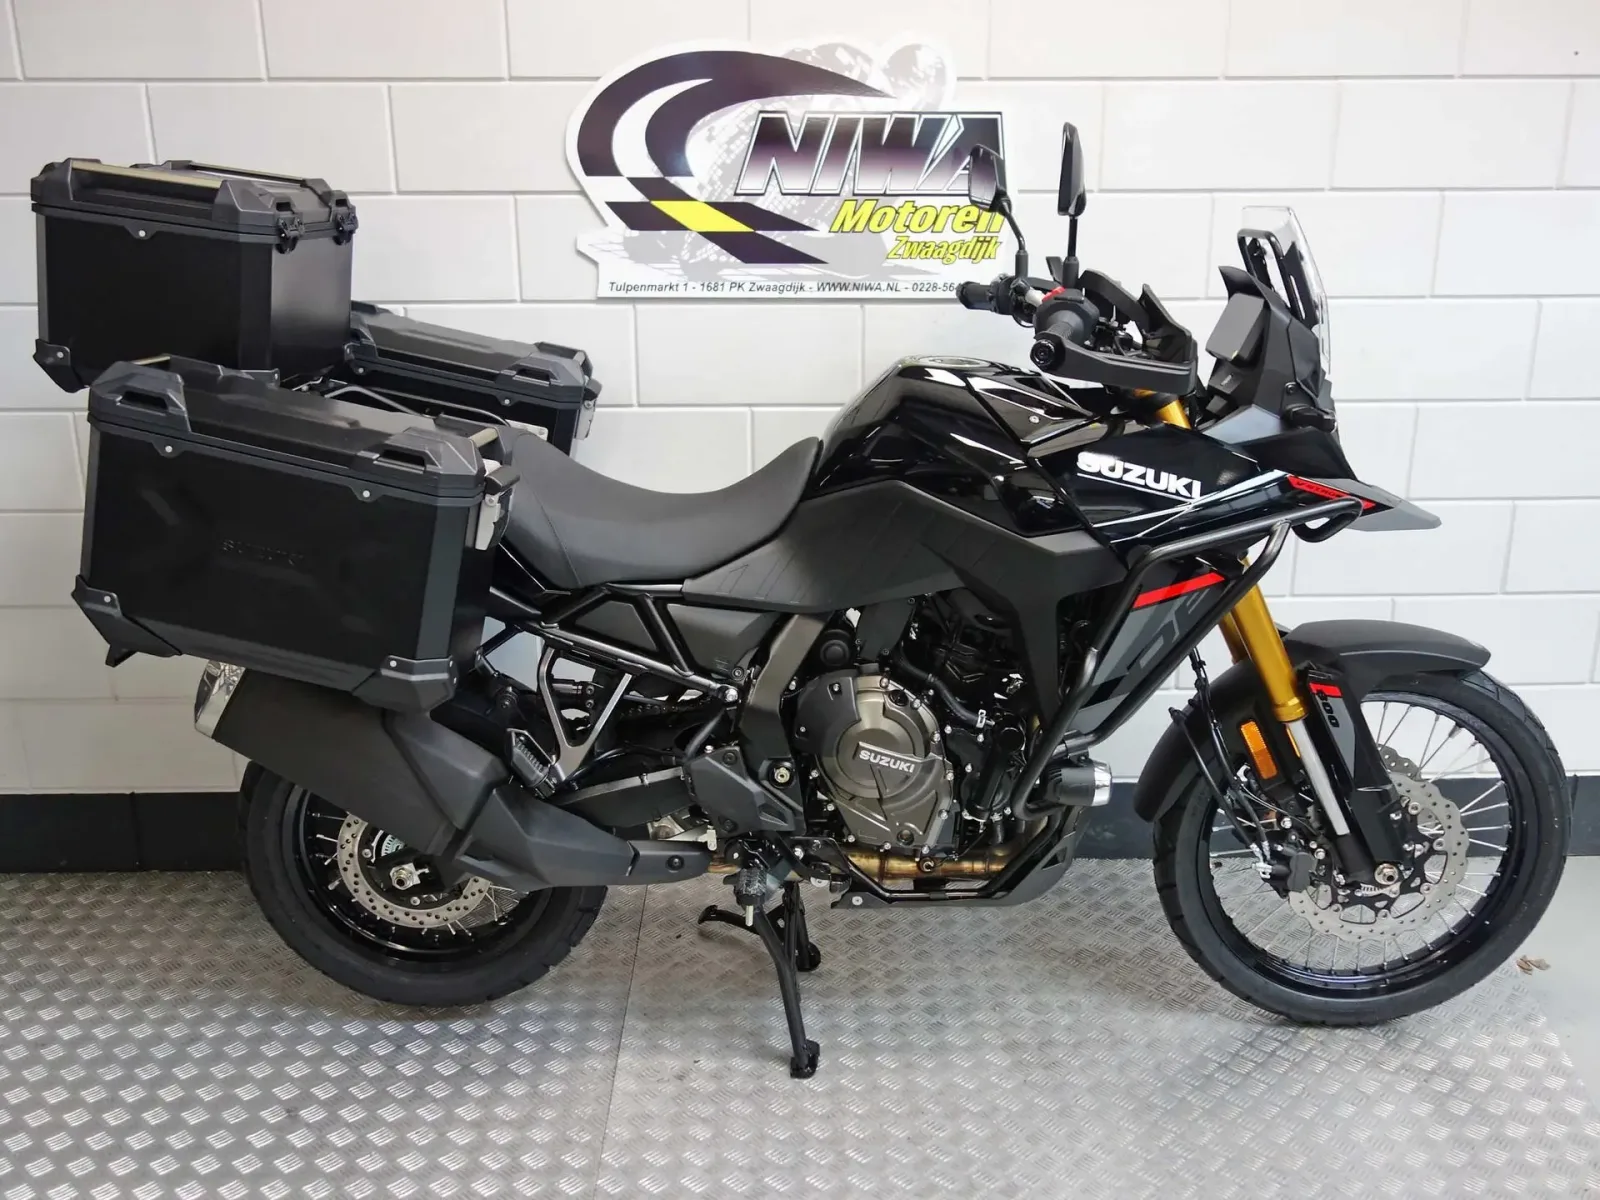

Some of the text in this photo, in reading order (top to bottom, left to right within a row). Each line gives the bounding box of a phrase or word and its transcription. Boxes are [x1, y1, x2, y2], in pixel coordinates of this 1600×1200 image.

[734, 110, 1004, 197] NIWA
[829, 199, 1006, 234] Motoren
[887, 236, 1002, 266] Zwaagdijk
[609, 281, 679, 294] Tulpenmarkt
[683, 282, 689, 292] 1
[700, 282, 725, 292] 1681
[729, 282, 745, 292] PK
[749, 282, 805, 295] Zwaagdijk
[816, 282, 902, 292] WWW.NIWA.NL
[1077, 451, 1202, 499] SUZUKI
[859, 749, 916, 774] SUZUKI
